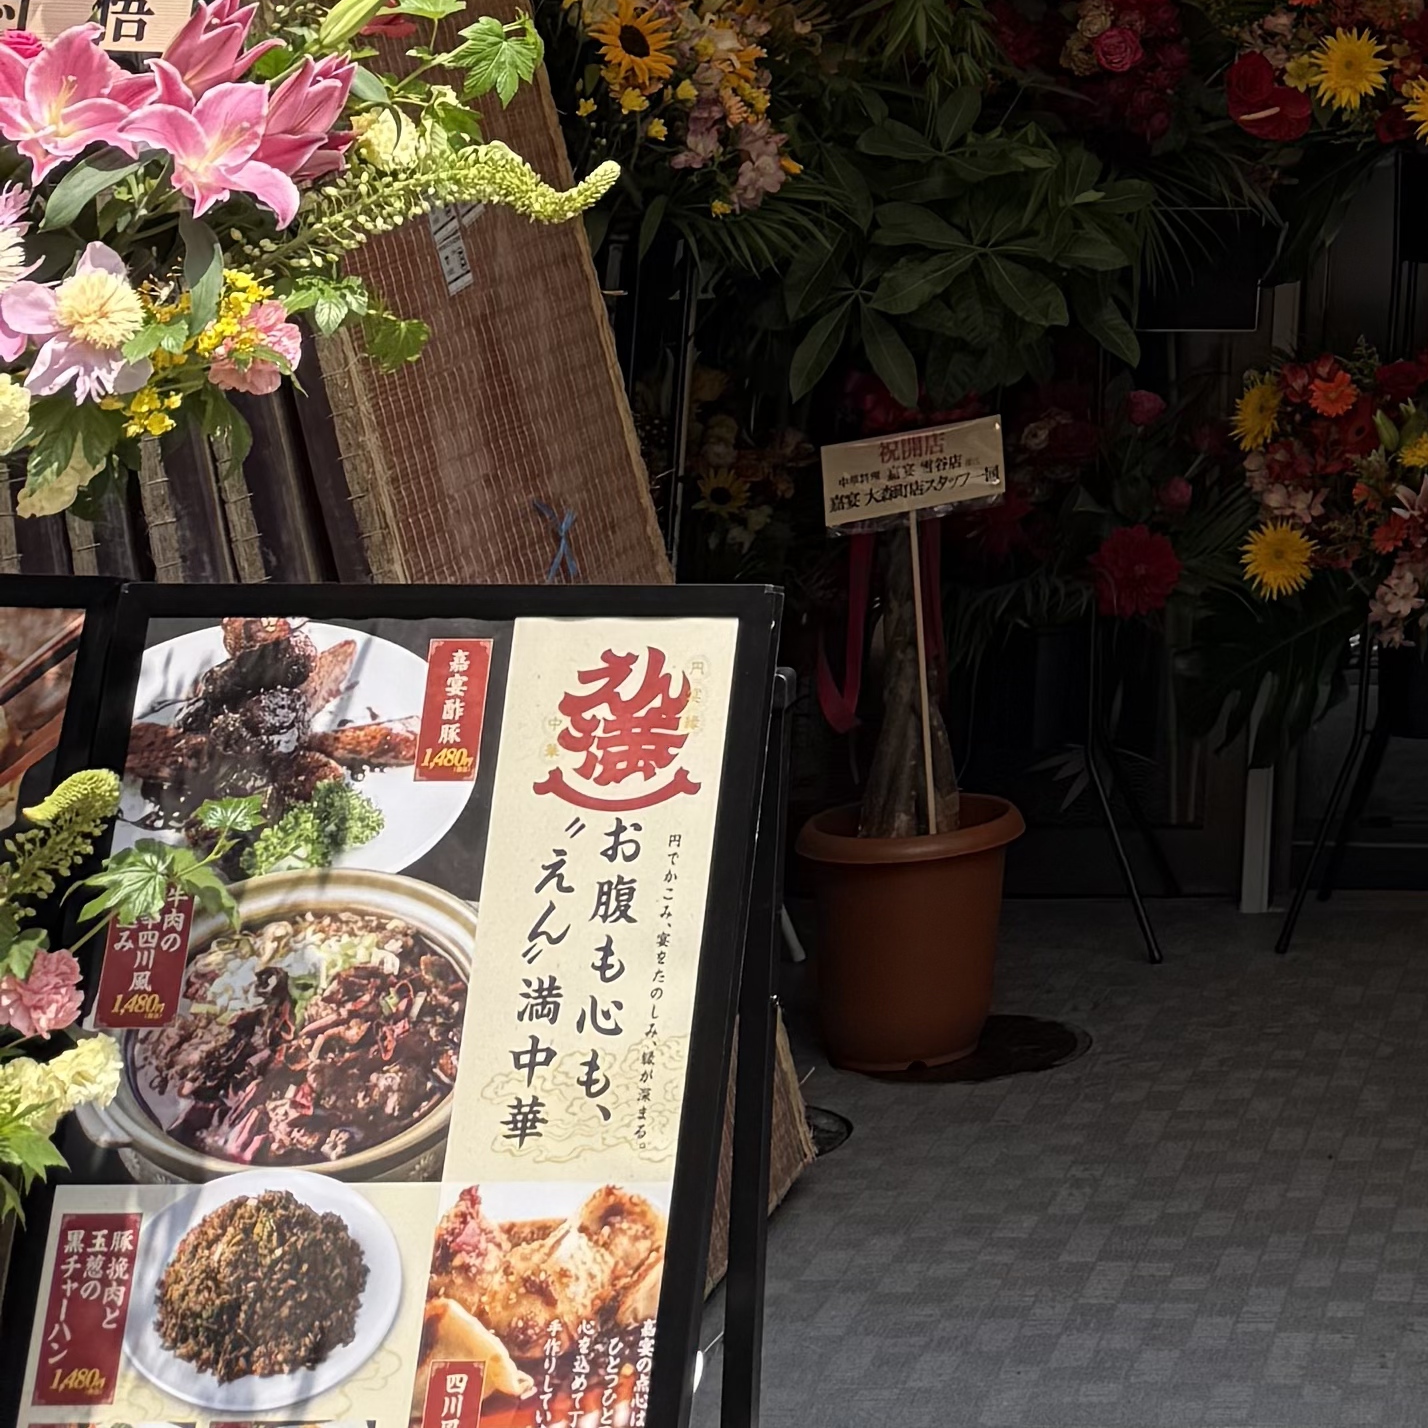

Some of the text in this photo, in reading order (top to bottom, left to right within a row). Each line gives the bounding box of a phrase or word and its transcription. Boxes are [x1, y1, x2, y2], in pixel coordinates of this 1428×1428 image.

[879, 431, 946, 465] 祝開店
[437, 649, 471, 744] 嘉宴酢豚
[48, 1229, 86, 1364] 黒チャーハン
[535, 1319, 563, 1428] 手作りしてい
[598, 1337, 623, 1428] ひとつひと
